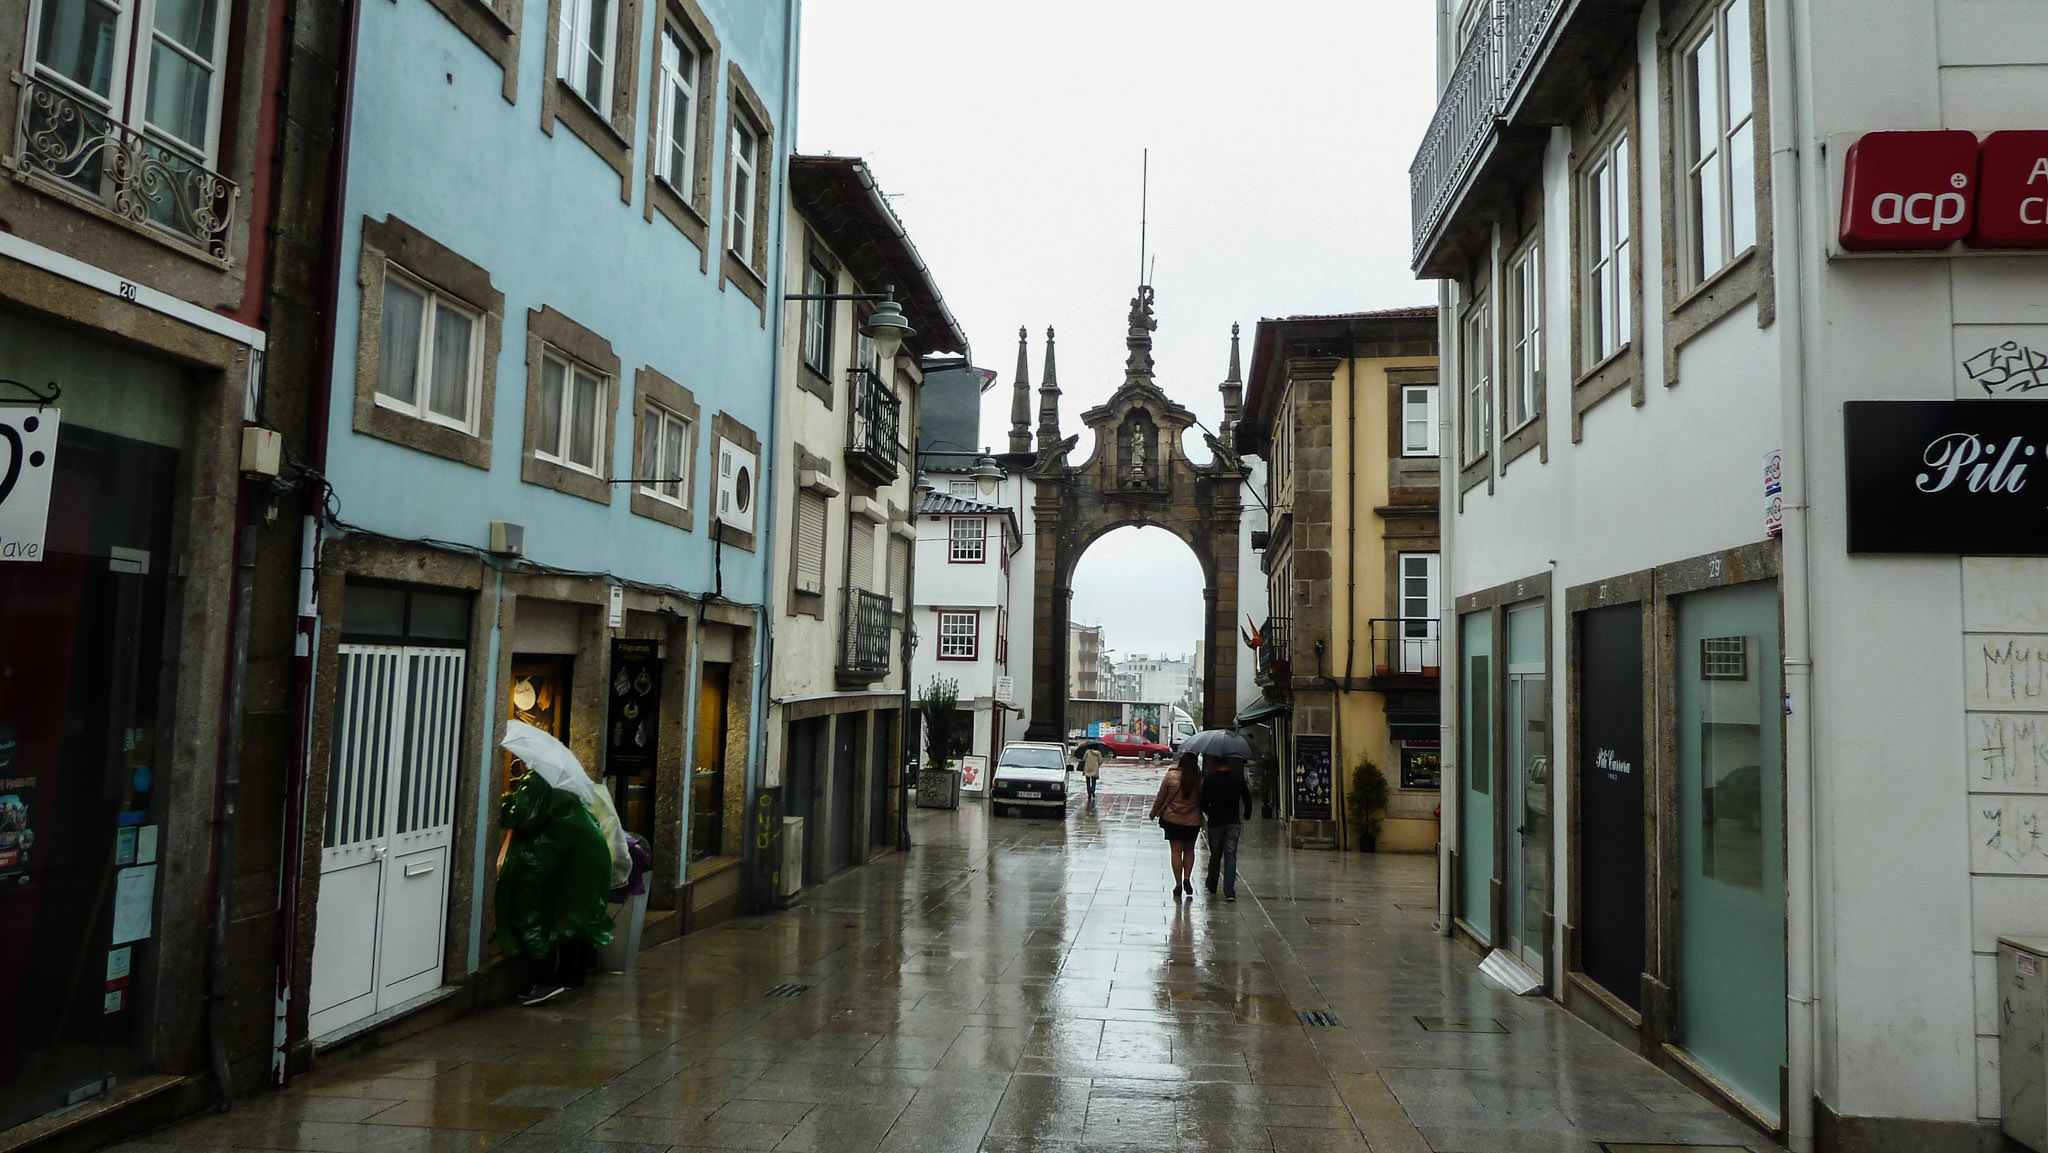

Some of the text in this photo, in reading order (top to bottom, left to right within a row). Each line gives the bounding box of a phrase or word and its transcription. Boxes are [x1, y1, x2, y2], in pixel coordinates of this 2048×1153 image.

[1871, 192, 1966, 231] acp
[120, 283, 136, 300] 20
[1915, 432, 2036, 493] Pili
[1708, 559, 1721, 578] 29
[1598, 584, 1607, 599] 27
